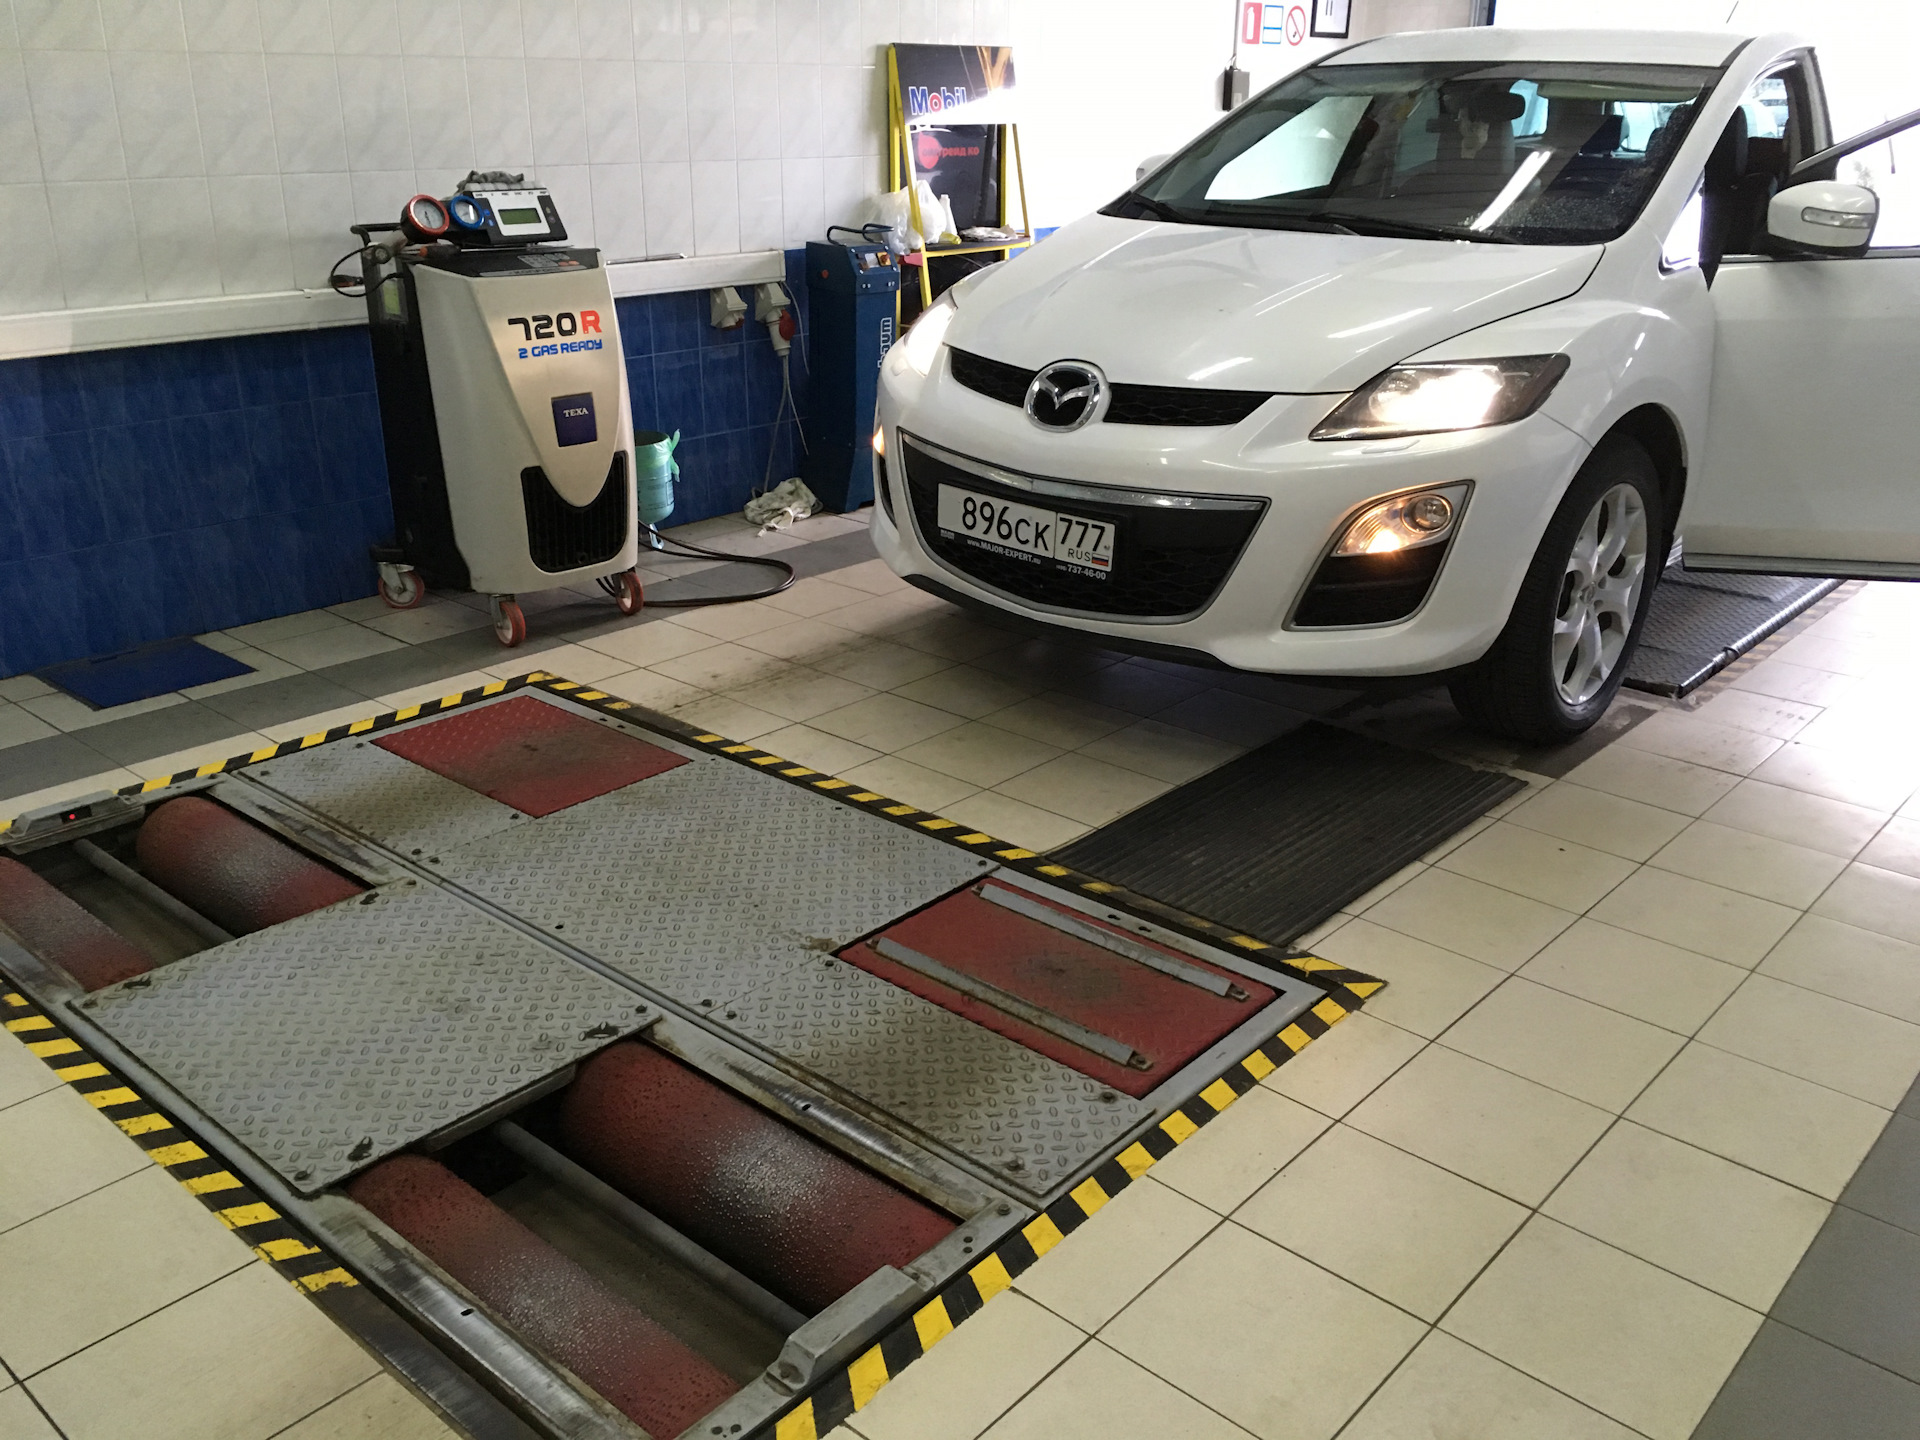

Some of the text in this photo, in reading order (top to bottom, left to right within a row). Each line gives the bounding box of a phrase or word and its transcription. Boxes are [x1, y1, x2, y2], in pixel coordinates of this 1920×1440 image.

[908, 86, 967, 115] Mobil
[518, 339, 603, 359] 2 GAS READY
[563, 407, 589, 418] TEXA
[1059, 516, 1106, 552] 777
[1067, 548, 1091, 562] RUS
[1067, 564, 1107, 581] 737-46-00
